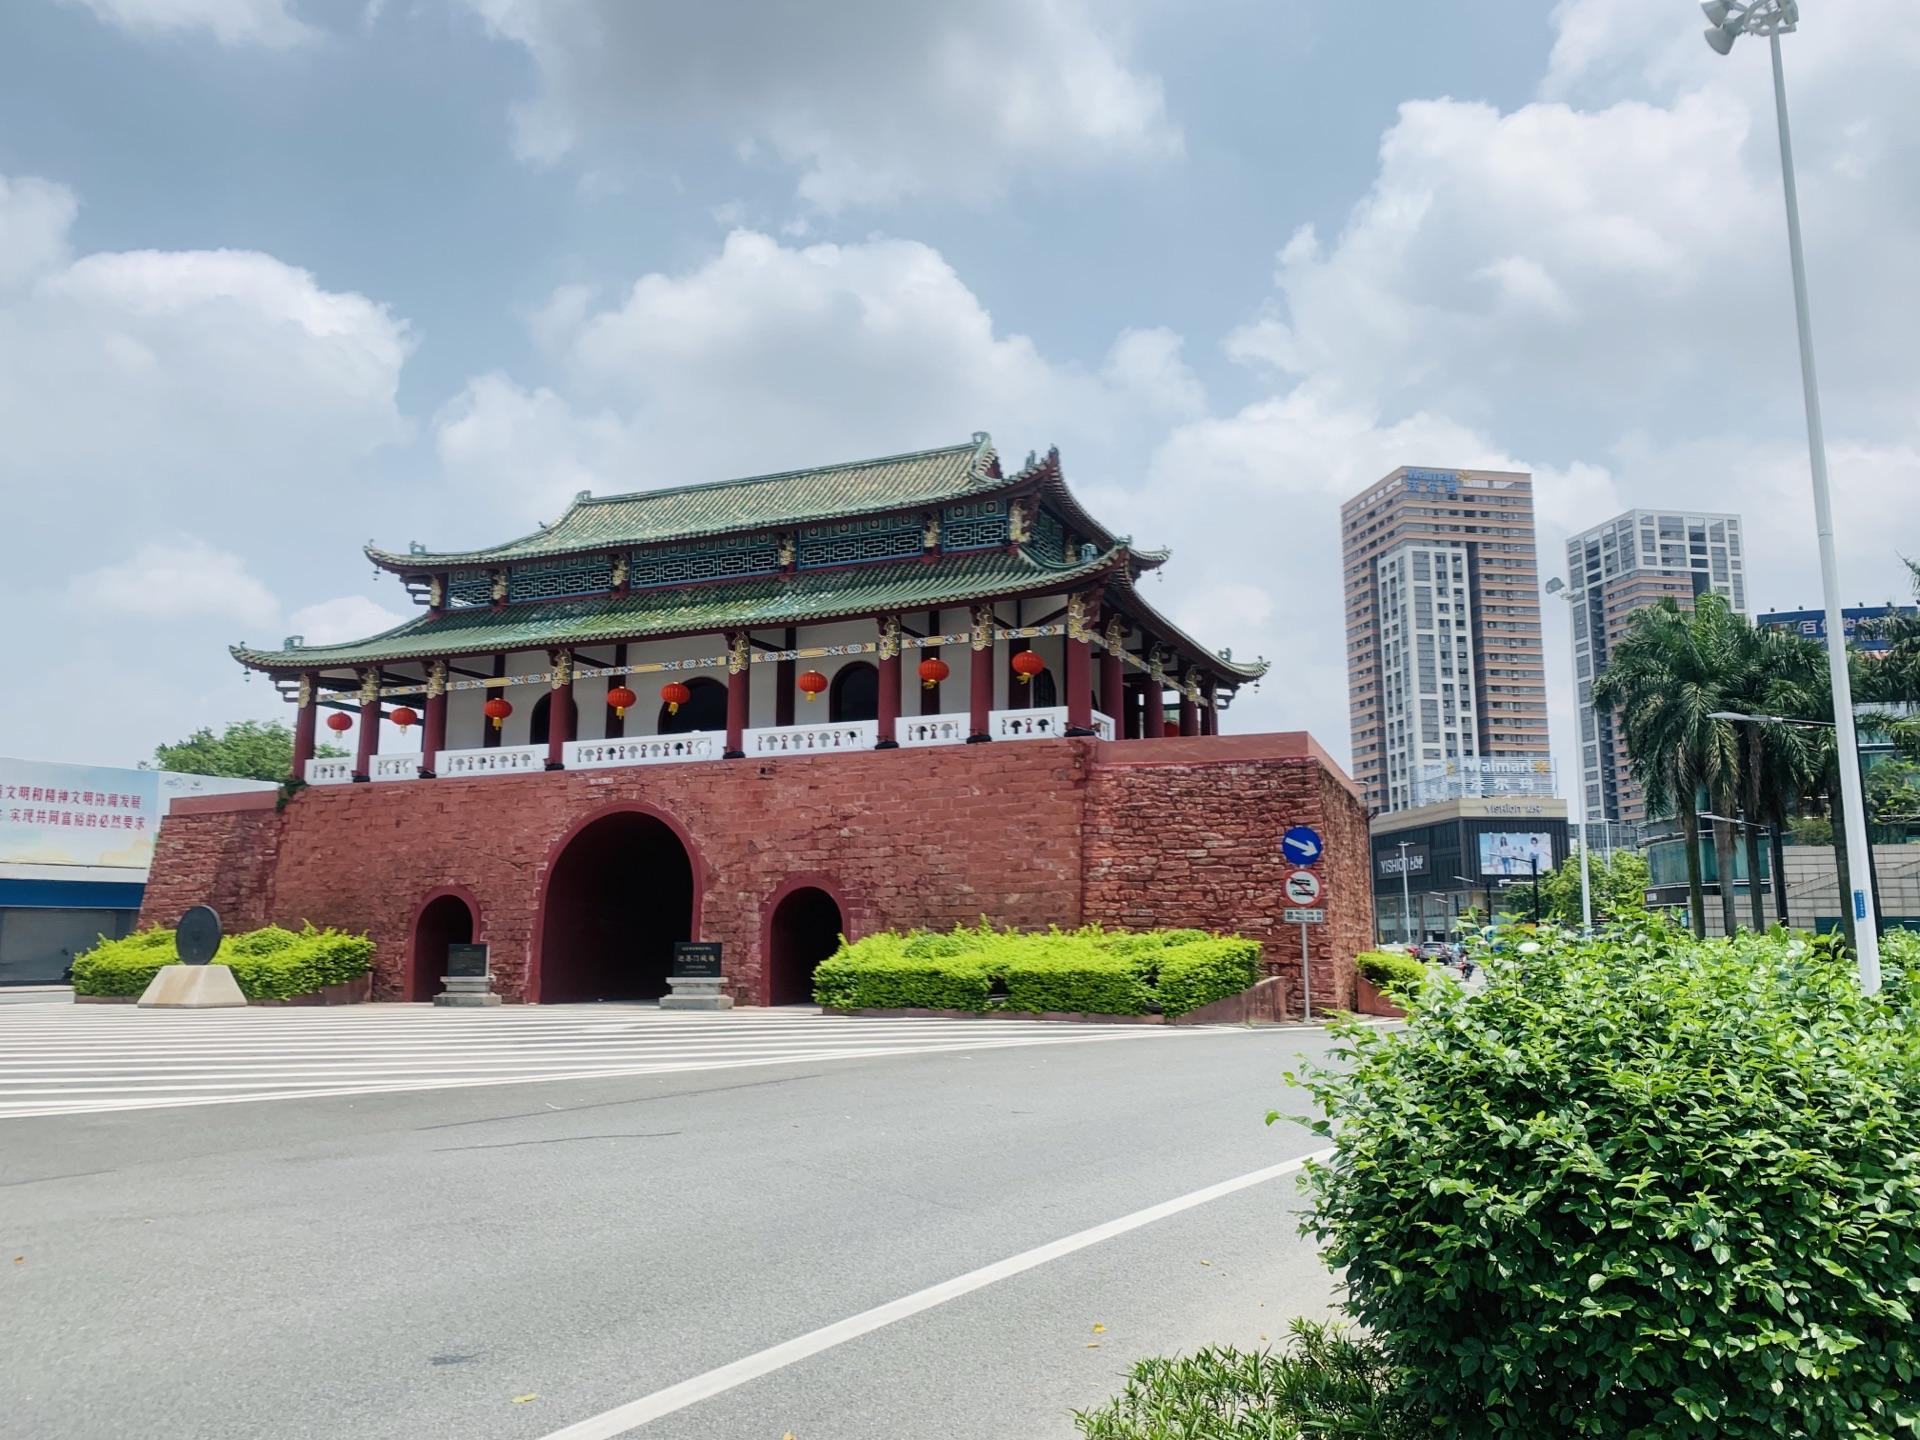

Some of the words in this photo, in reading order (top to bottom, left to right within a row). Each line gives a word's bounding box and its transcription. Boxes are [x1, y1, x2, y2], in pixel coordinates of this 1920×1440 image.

[1463, 758, 1533, 773] Walmart
[0, 784, 141, 808] 文明和精神文明协调发展
